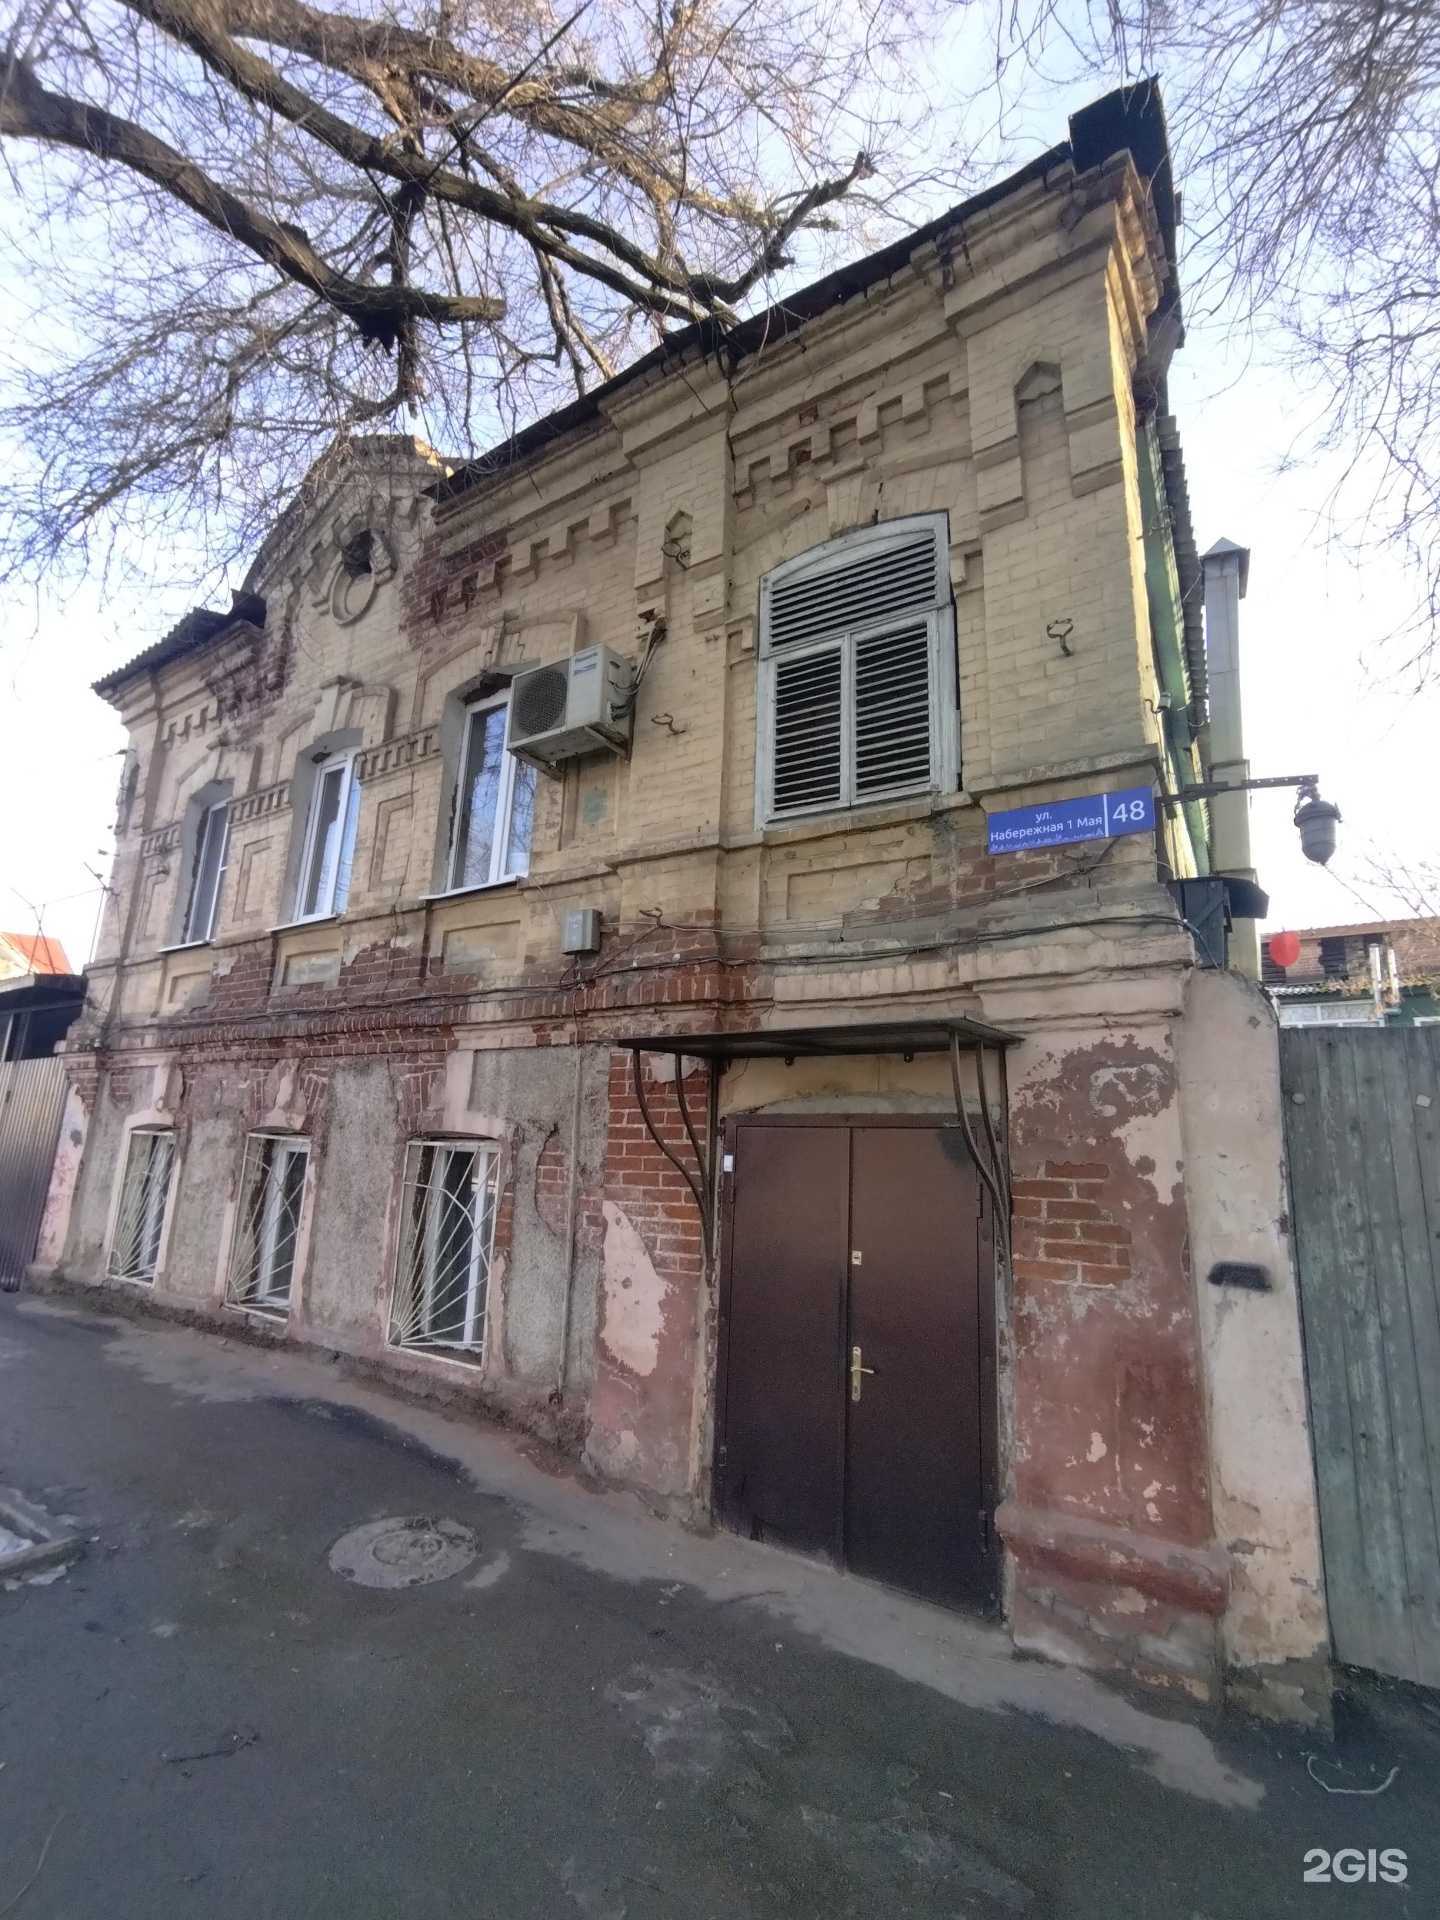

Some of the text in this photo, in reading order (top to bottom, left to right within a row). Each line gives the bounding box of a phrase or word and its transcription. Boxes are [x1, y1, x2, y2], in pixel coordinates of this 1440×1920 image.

[1035, 811, 1053, 824] ул.
[1112, 800, 1146, 823] 48
[990, 822, 1064, 842] Набережная
[1066, 819, 1073, 830] 1
[1077, 816, 1103, 829] Мая
